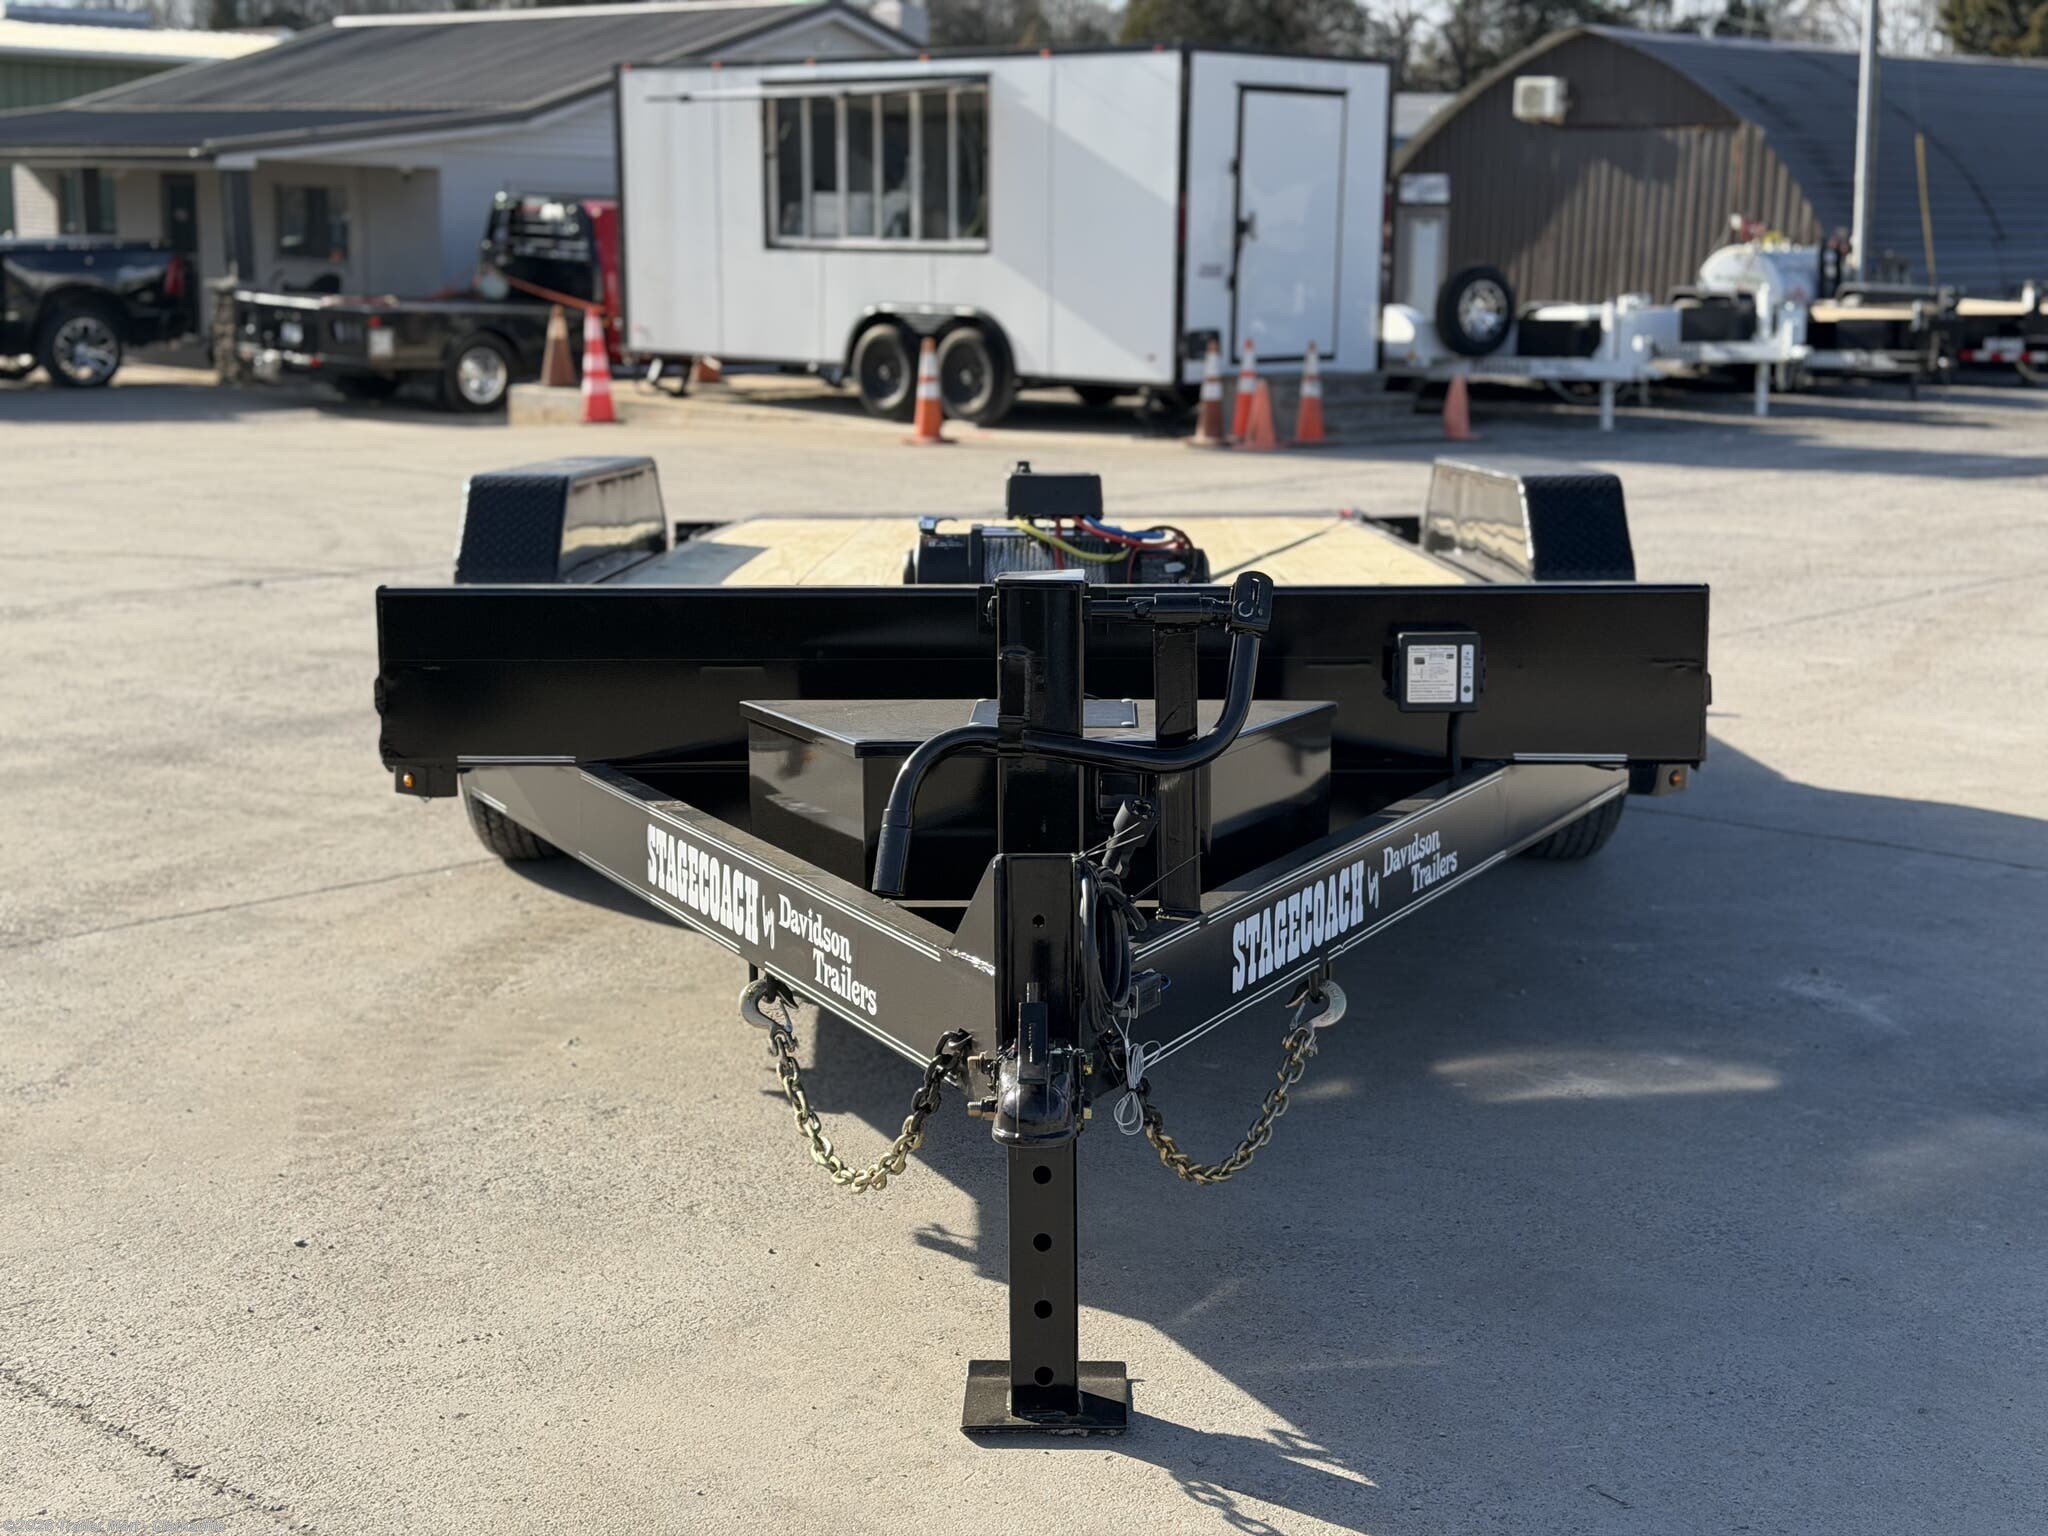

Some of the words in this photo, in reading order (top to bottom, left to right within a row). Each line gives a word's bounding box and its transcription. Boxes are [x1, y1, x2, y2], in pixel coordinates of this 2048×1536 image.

[647, 823, 759, 945] STAGECOACH
[762, 894, 775, 950] by
[778, 893, 853, 964] Davidson
[1232, 860, 1364, 994] STAGECOACH
[1368, 866, 1380, 909] by
[1382, 829, 1441, 878] Davidson
[1411, 850, 1458, 894] Trailers
[812, 950, 878, 1016] Trailers
